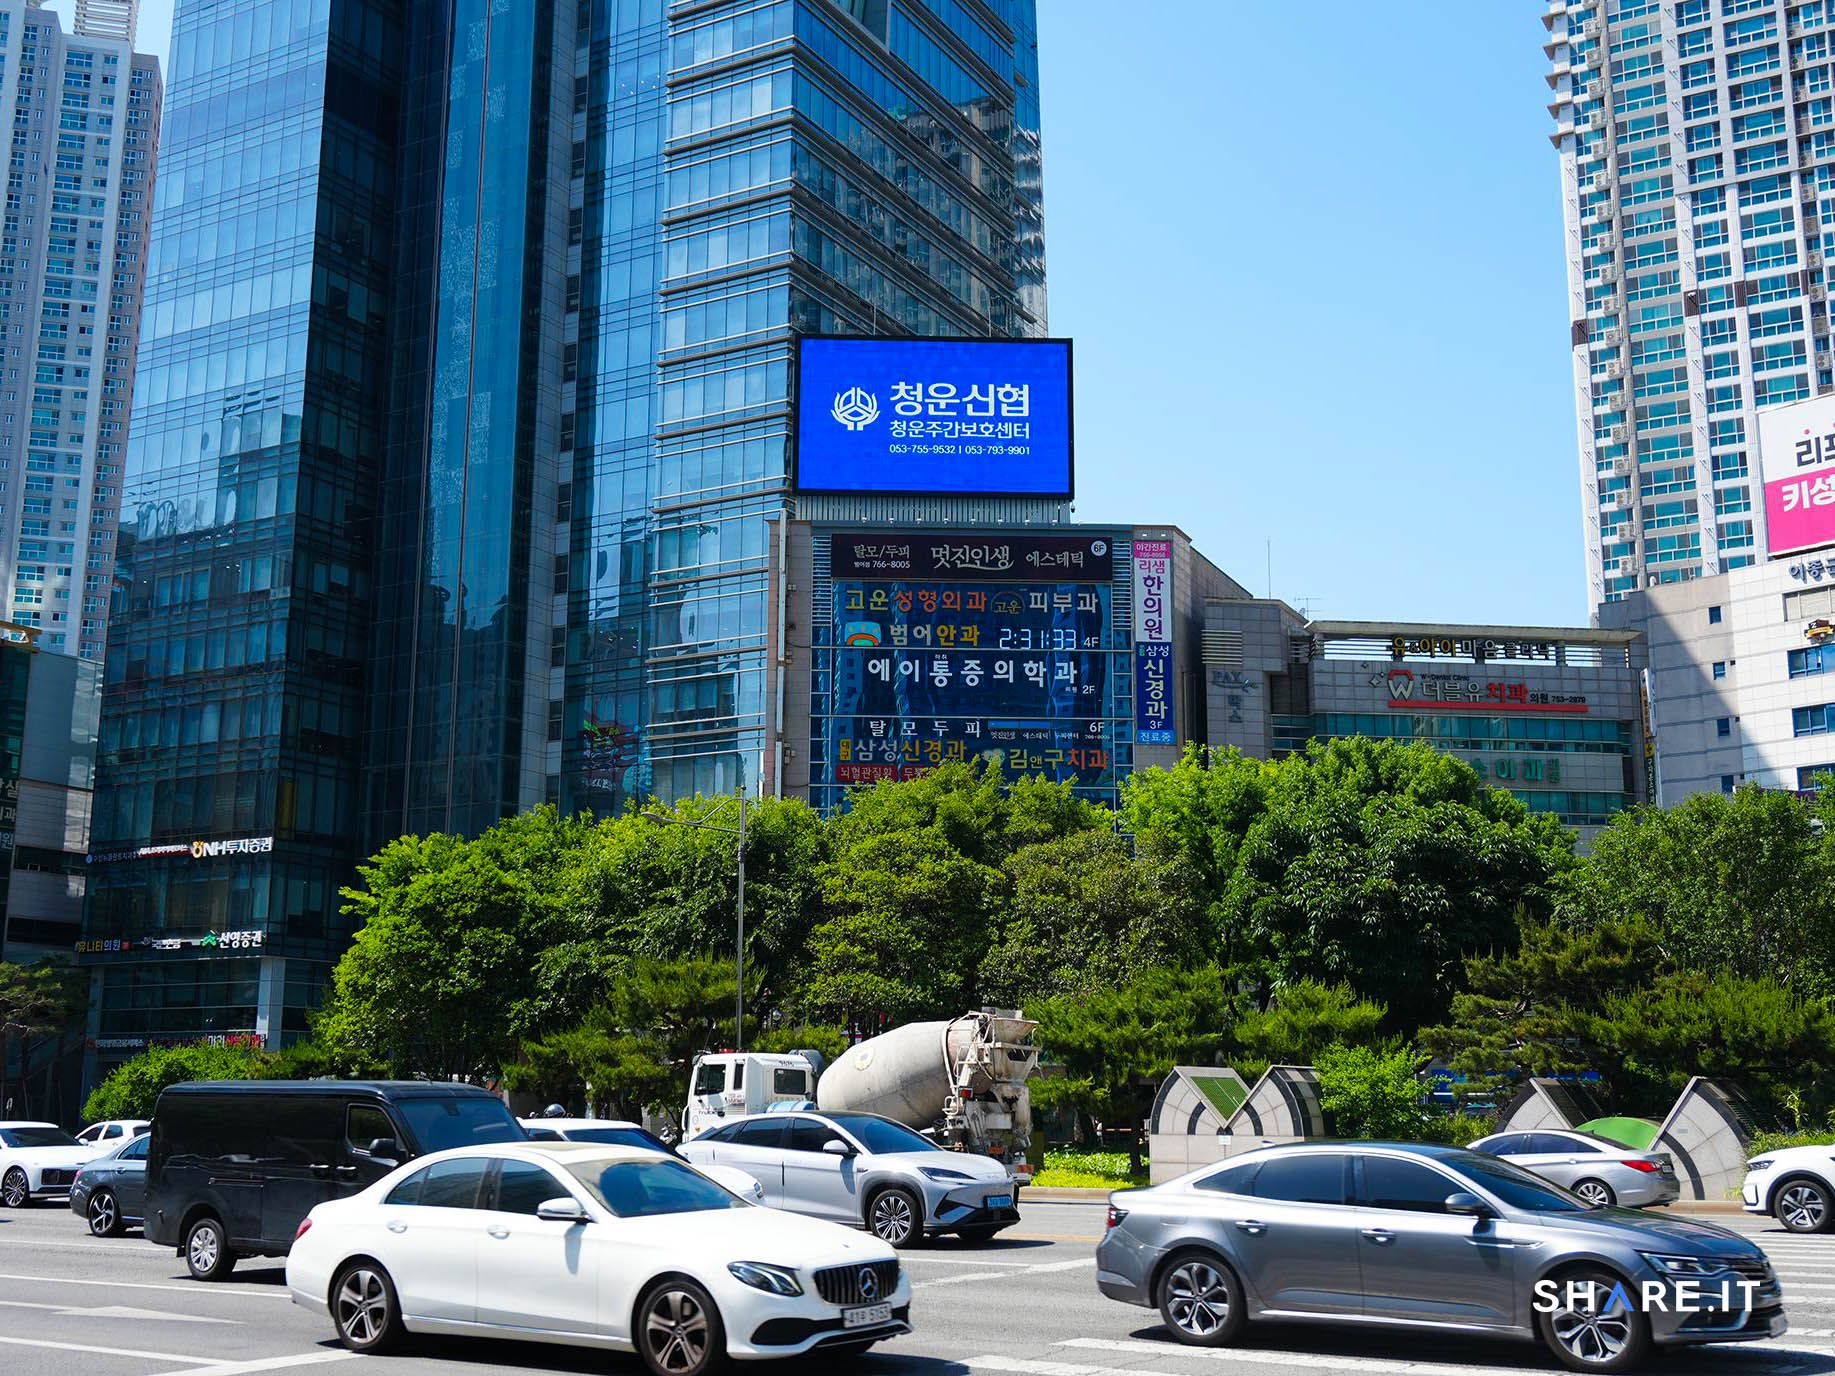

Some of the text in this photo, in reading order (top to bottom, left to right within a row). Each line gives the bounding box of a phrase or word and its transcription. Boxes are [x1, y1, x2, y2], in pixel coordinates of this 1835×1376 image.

[889, 381, 1030, 417] 청운신협
[889, 420, 1030, 440] 청운주간보호센터
[889, 444, 1031, 456] 053-755-9532 053-793-9901
[931, 544, 1014, 571] 멋진인생
[1025, 550, 1083, 569] 에스테틱
[1138, 560, 1166, 575] 리샘
[844, 588, 988, 613] 고운성형외과
[1029, 591, 1099, 614] 피부과
[1142, 574, 1165, 641] 한의원
[889, 623, 980, 647] 범어안과
[1083, 636, 1099, 648] 4F
[1146, 644, 1170, 657] 삼성
[867, 658, 1078, 688] 에이통증의학과
[1082, 684, 1096, 695] 2F
[1143, 658, 1169, 720] 신경과
[1089, 721, 1105, 734] 6F
[1149, 720, 1163, 730] 3F
[202, 836, 273, 857] NH투자증권
